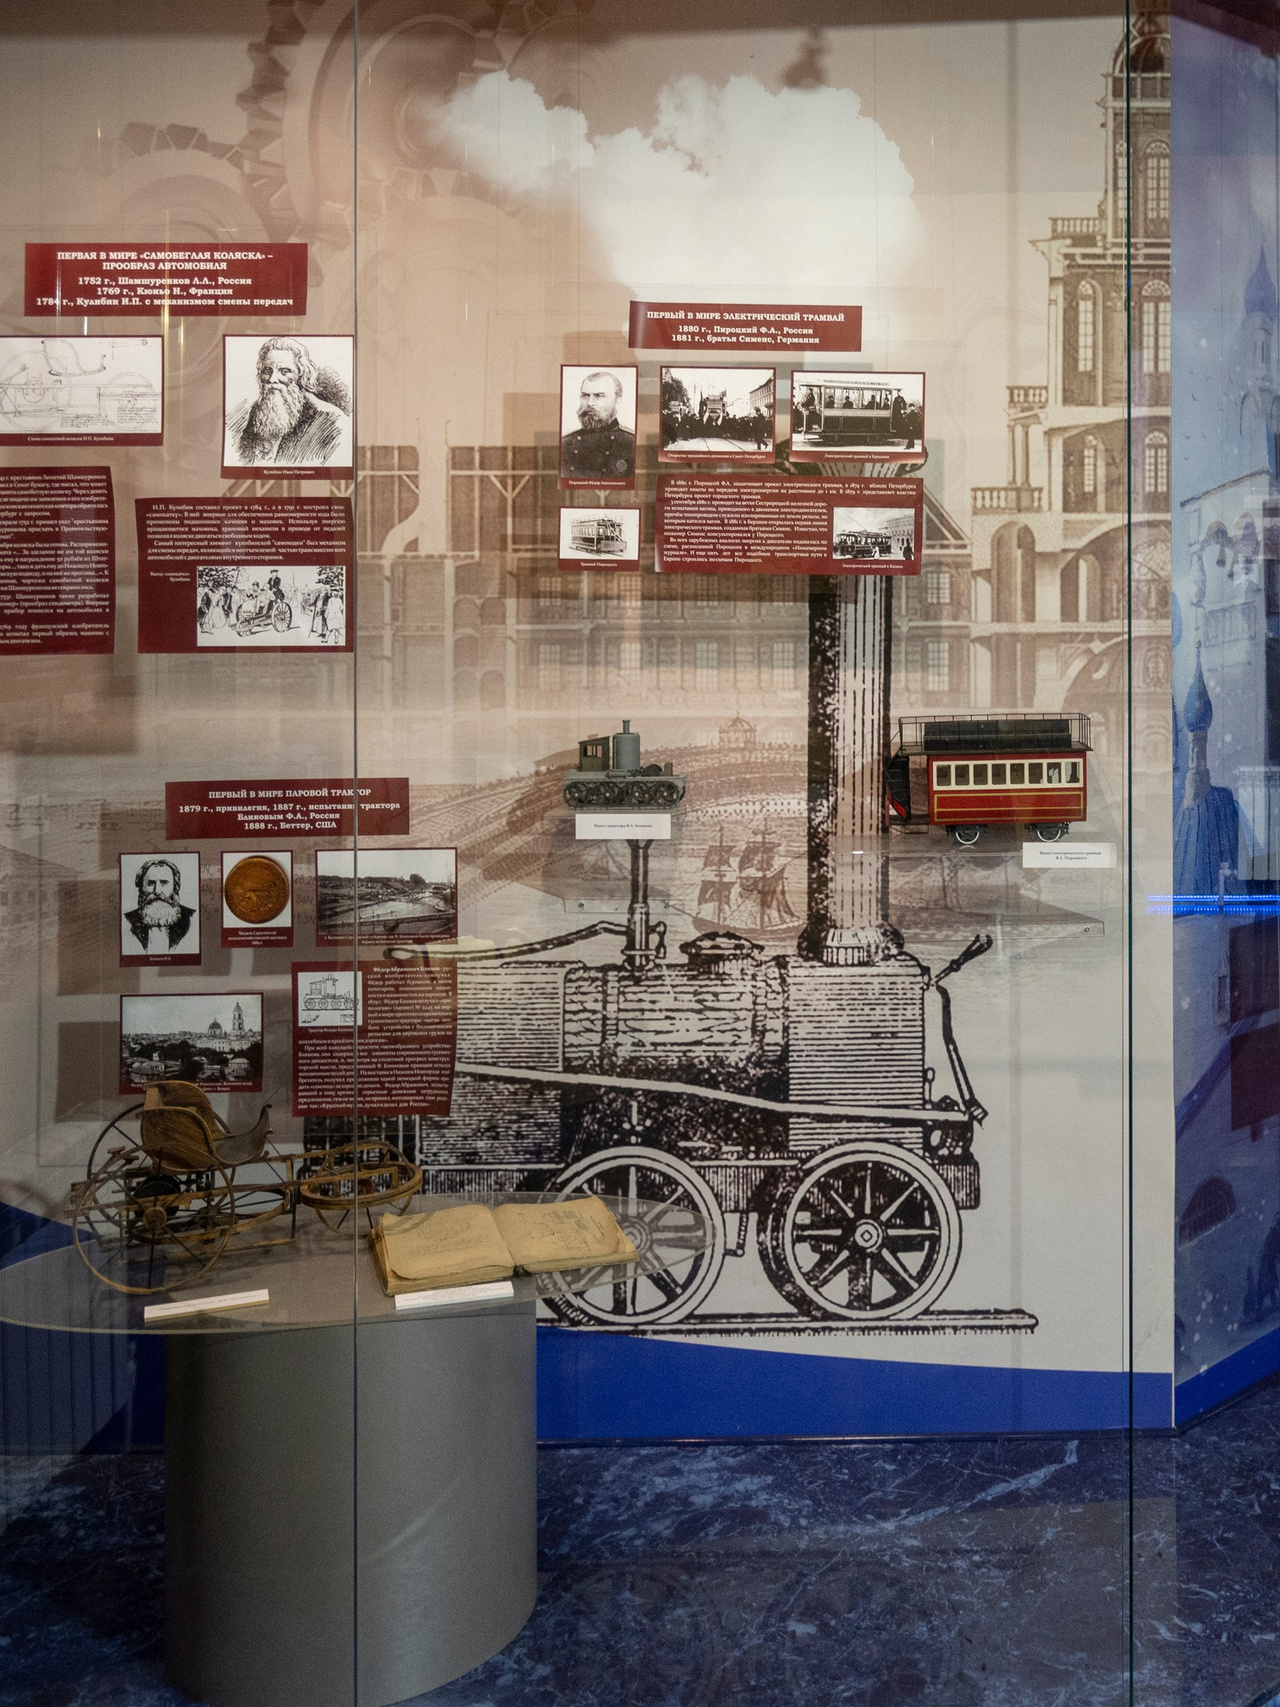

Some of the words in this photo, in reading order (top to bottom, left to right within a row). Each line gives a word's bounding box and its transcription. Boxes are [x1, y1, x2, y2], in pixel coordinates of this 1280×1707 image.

[57, 252, 97, 260] ПЕРВАЯ
[100, 252, 107, 260] В
[103, 262, 155, 270] ПРООБРАЗ
[157, 262, 227, 270] АВТОМОБИЛЯ
[79, 277, 102, 285] 1752
[118, 277, 190, 286] Шамшуренков
[97, 287, 120, 295] 1769
[137, 287, 170, 295] Кюньо
[173, 287, 187, 296] Н.,
[189, 288, 233, 296] Франция
[37, 298, 61, 306] 1784
[76, 298, 119, 306] Кулибин
[153, 298, 215, 307] механизмом
[647, 311, 685, 319] ПЕРВЫЙ
[803, 313, 845, 321] ТРАМВАЙ
[714, 326, 758, 334] Пироцкий
[707, 335, 737, 343] братья
[777, 336, 819, 344] Германия
[209, 790, 247, 798] ПЕРВЫЙ
[286, 789, 328, 797] ПАРОВОЙ
[280, 822, 313, 830] Беттер,
